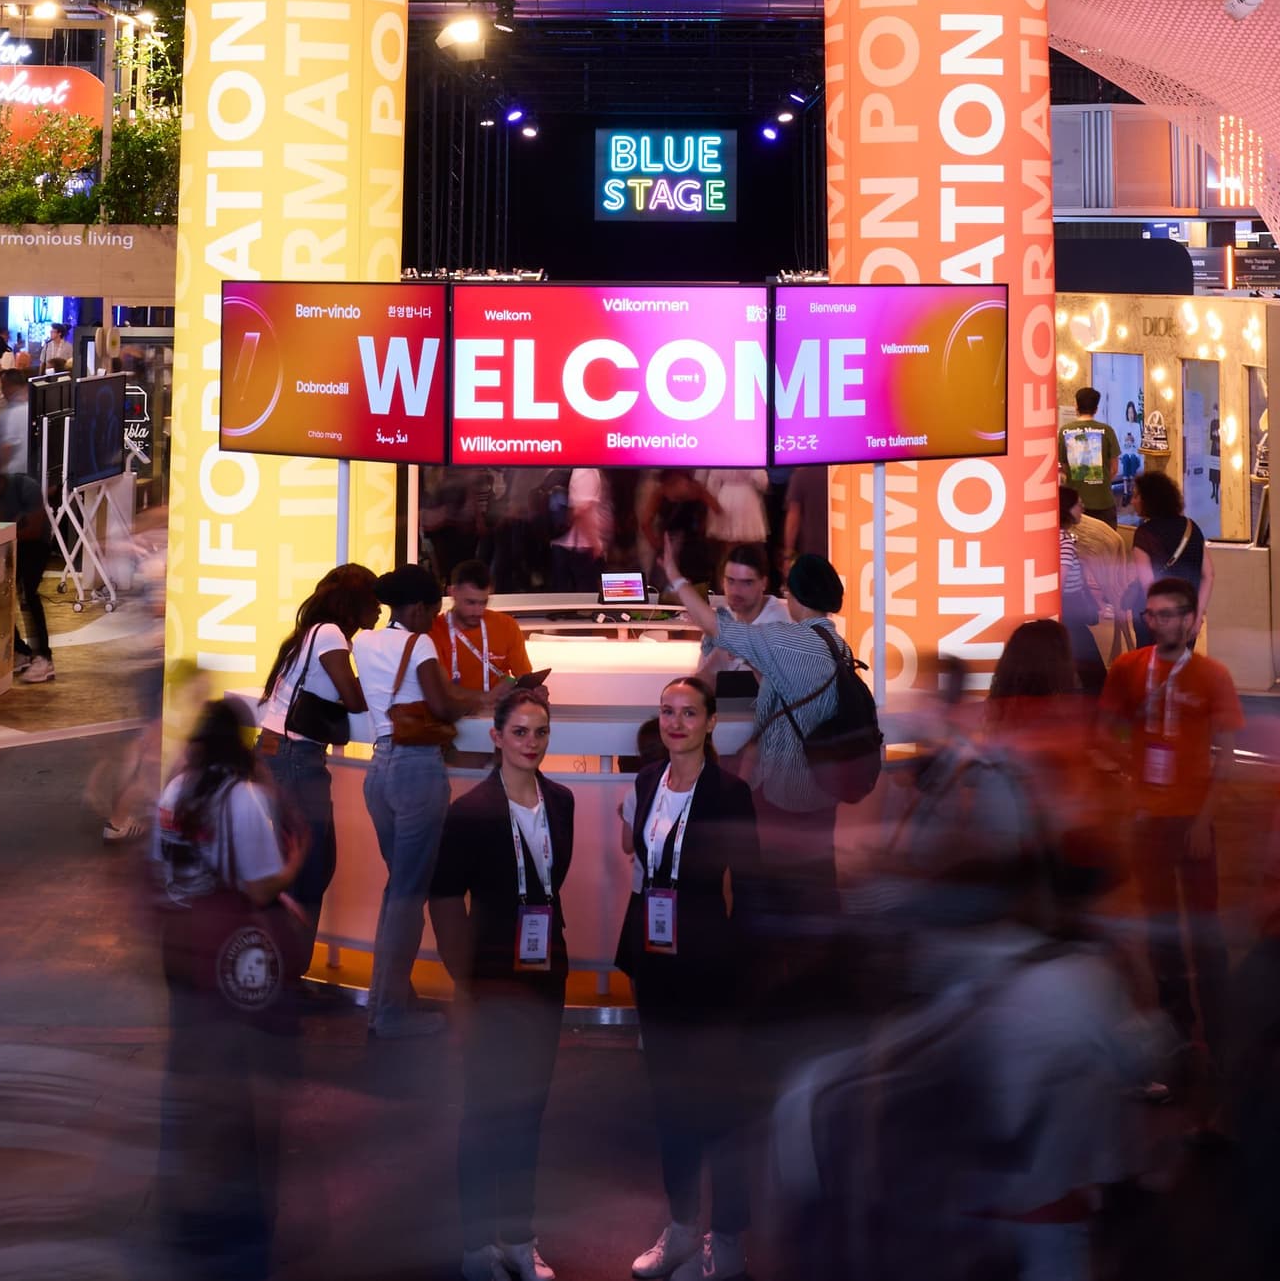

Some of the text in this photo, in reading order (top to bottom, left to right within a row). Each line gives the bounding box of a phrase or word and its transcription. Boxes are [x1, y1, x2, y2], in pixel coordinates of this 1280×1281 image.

[610, 135, 722, 173] BLUE
[602, 178, 726, 212] STAGE
[88, 231, 134, 250] living
[295, 304, 361, 319] Bem-vindo
[387, 305, 433, 319] 환영합니다
[602, 298, 690, 312] Välkommen
[809, 302, 857, 314] Bienvenue
[484, 310, 532, 321] Welkom
[880, 343, 930, 355] Velkommen
[936, 14, 1007, 691] INFOATION
[358, 336, 866, 421] WELCOME
[296, 380, 349, 395] Dobrodošli
[460, 435, 562, 453] Willkommen
[606, 433, 699, 448] Bienvenido
[774, 434, 819, 452] ようこそ
[866, 434, 928, 448] Tere tulemast
